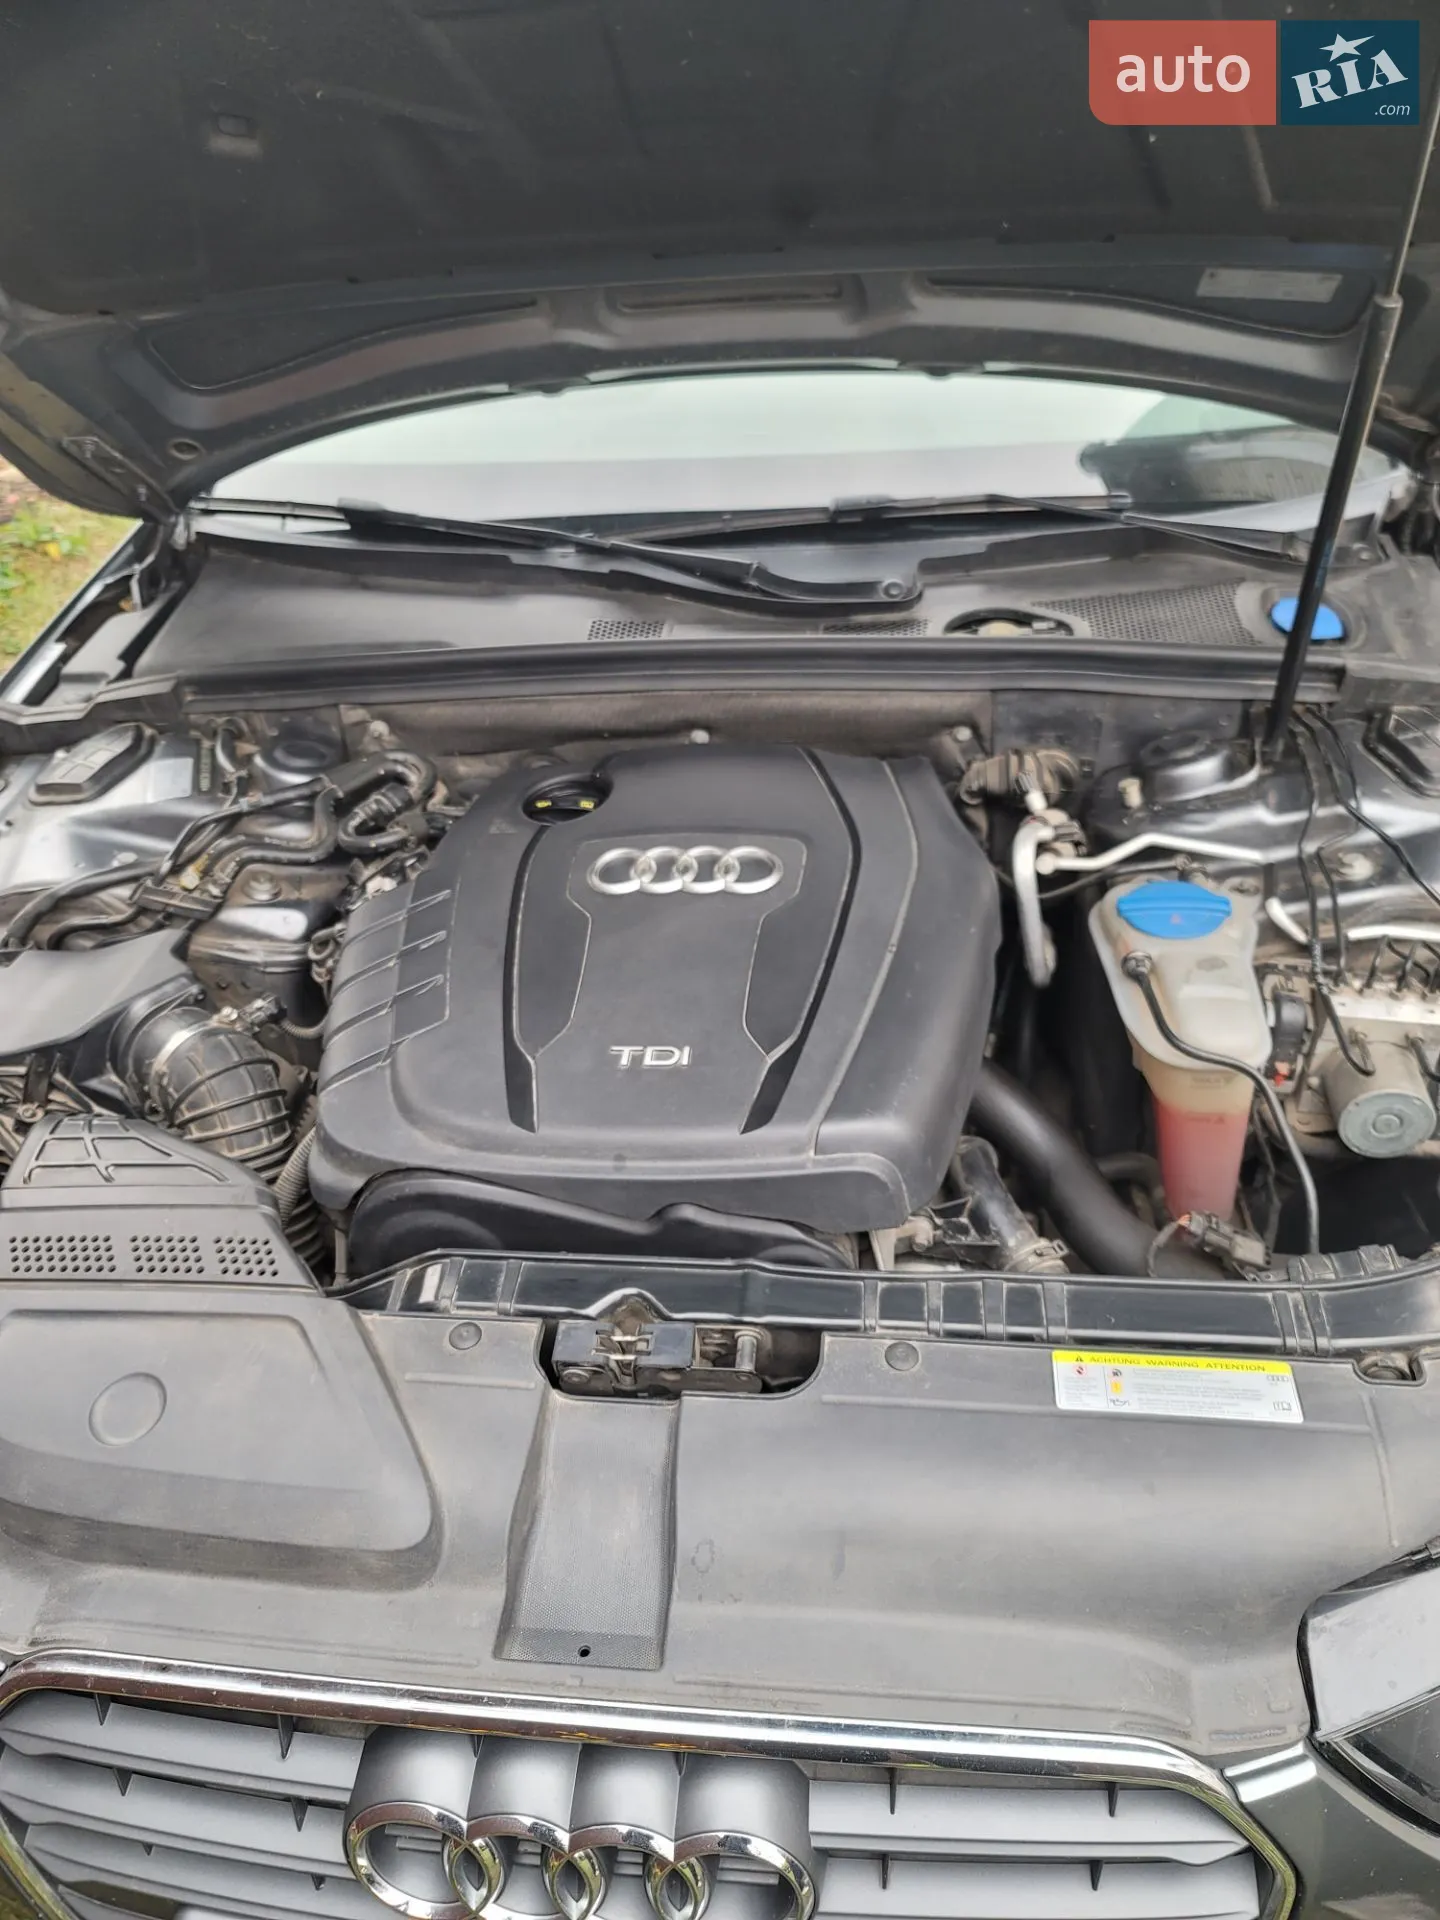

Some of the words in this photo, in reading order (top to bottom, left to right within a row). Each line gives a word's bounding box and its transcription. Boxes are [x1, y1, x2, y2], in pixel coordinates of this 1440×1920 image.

[609, 1046, 691, 1066] TDI
[1089, 1355, 1141, 1366] ACHTUNG
[1145, 1359, 1199, 1369] WARNING
[1205, 1362, 1266, 1372] ATTENTION
